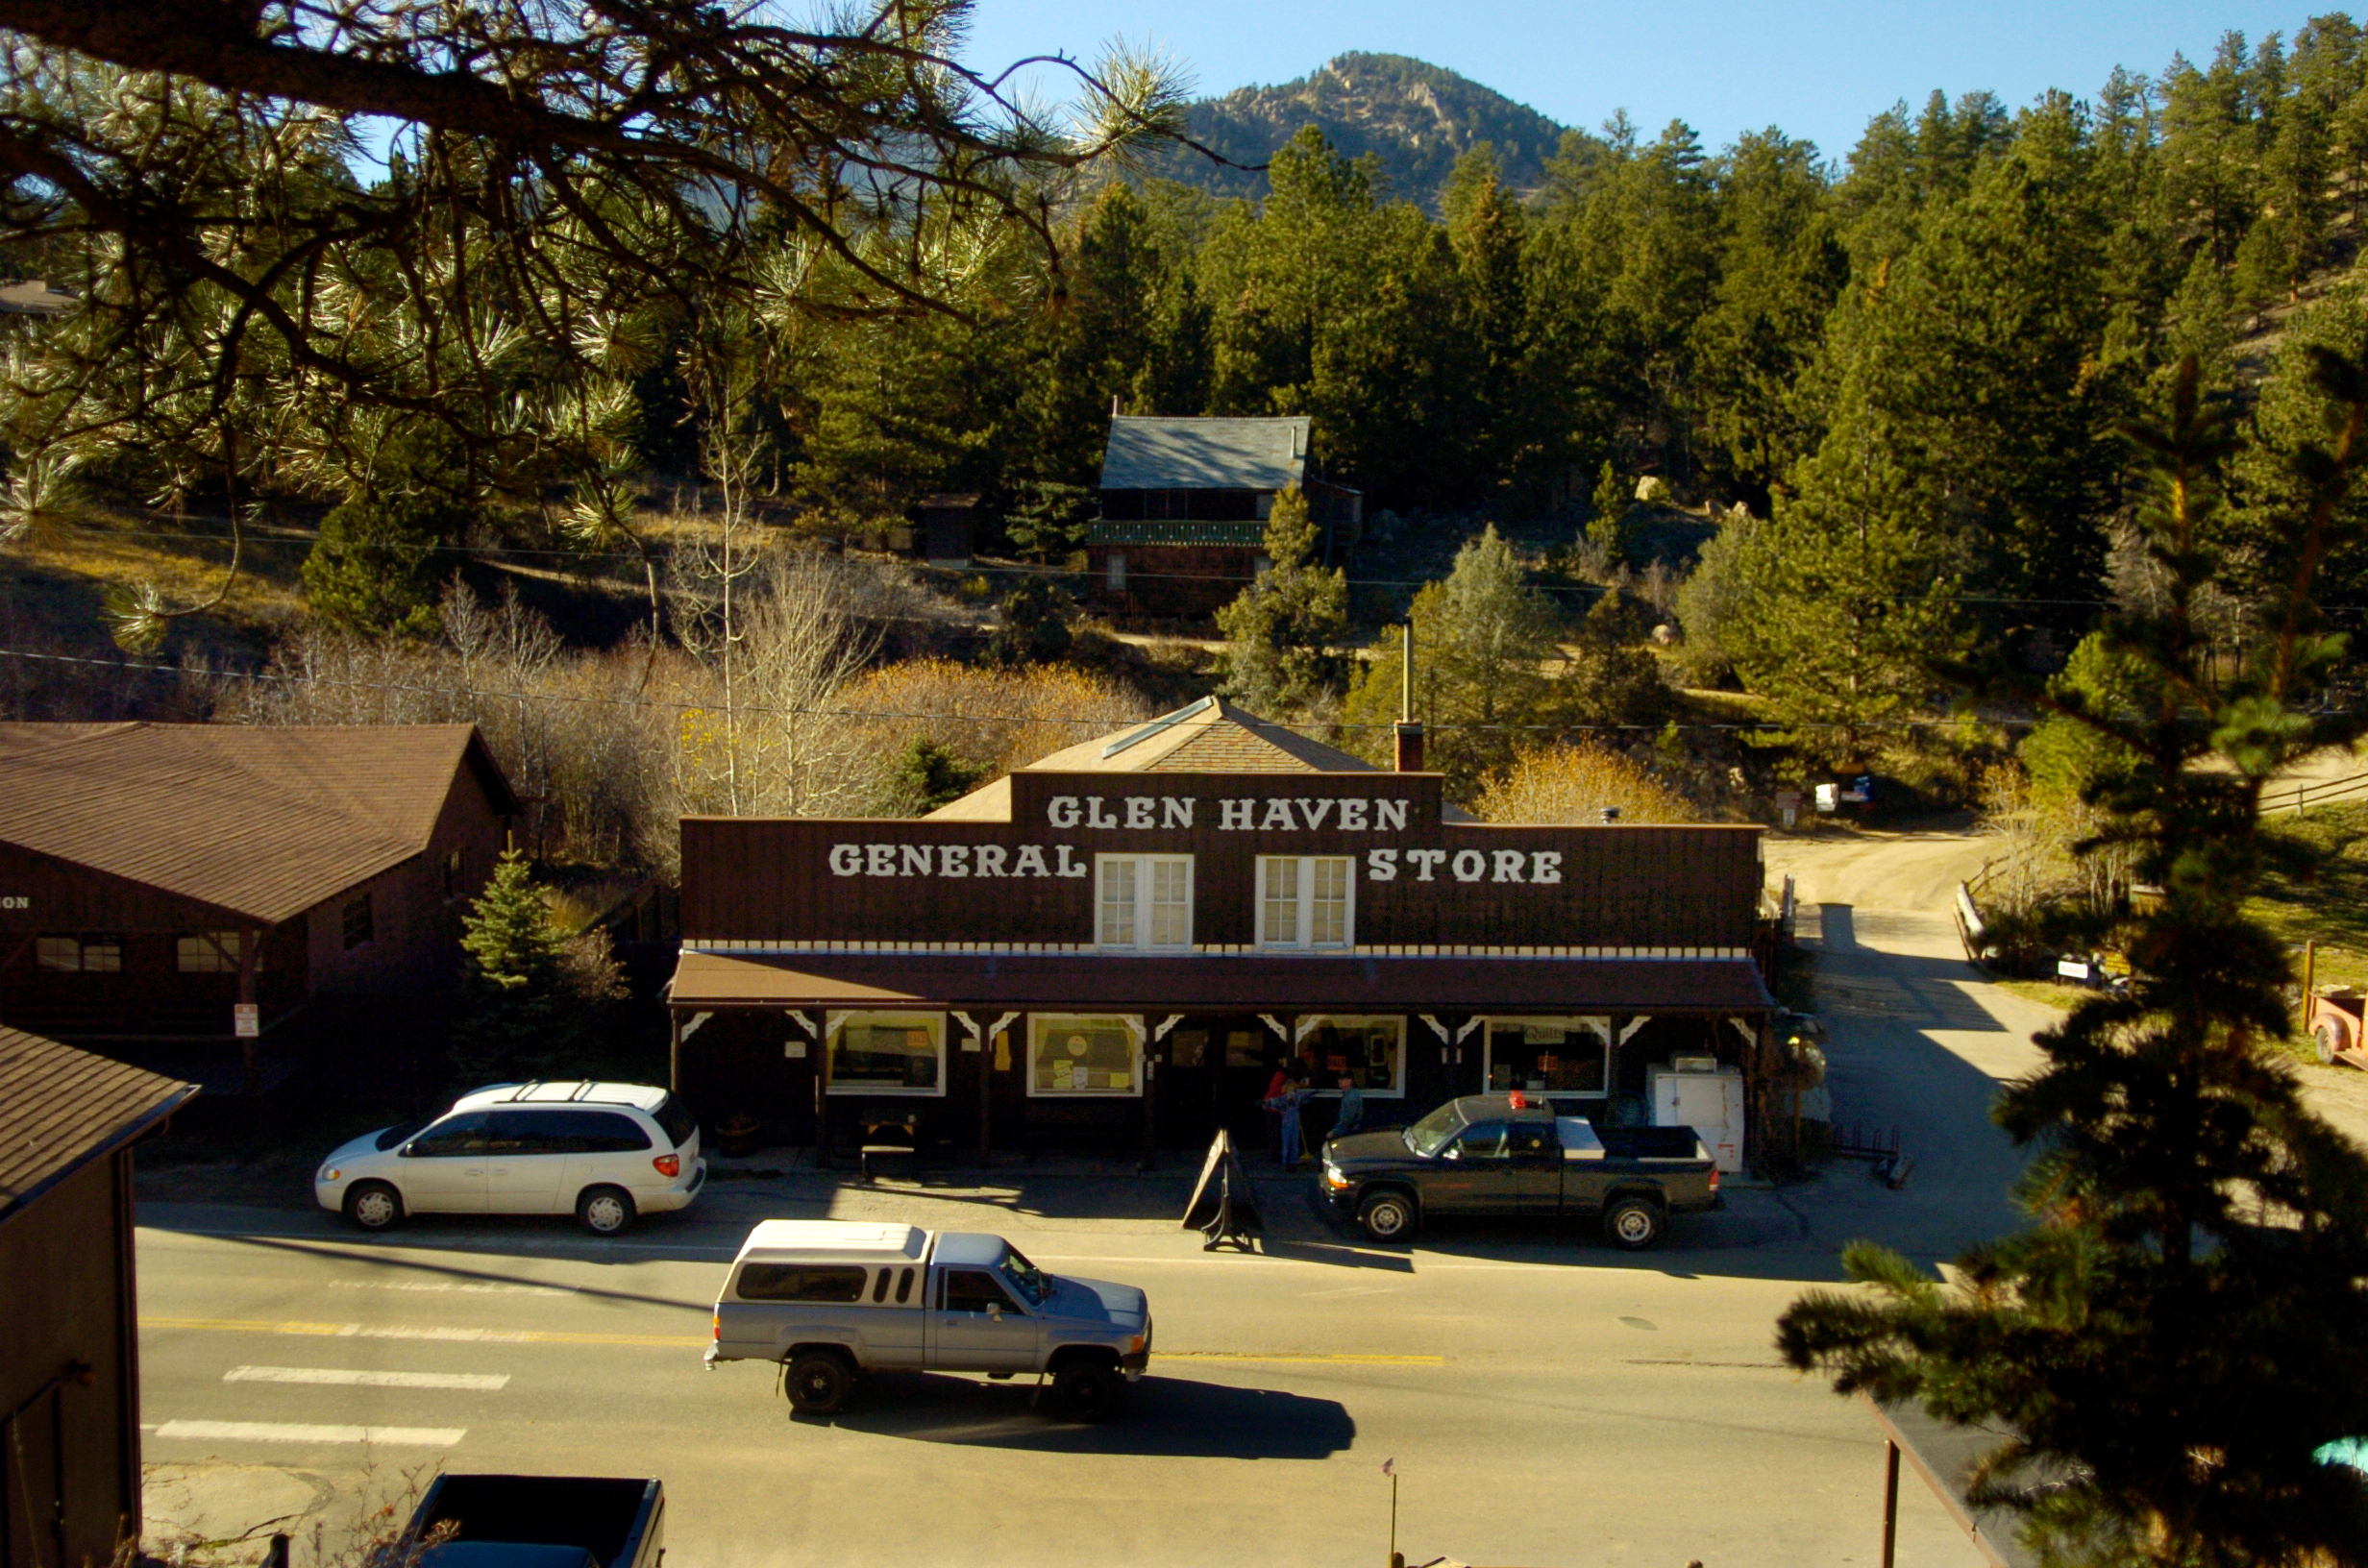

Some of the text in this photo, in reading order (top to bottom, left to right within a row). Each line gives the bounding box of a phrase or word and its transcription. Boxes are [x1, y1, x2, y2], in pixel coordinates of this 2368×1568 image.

[1047, 796, 1410, 831] GLEN HAVEN
[827, 844, 1563, 884] GENERAL STORE
[1526, 1025, 1565, 1040] Quilts
